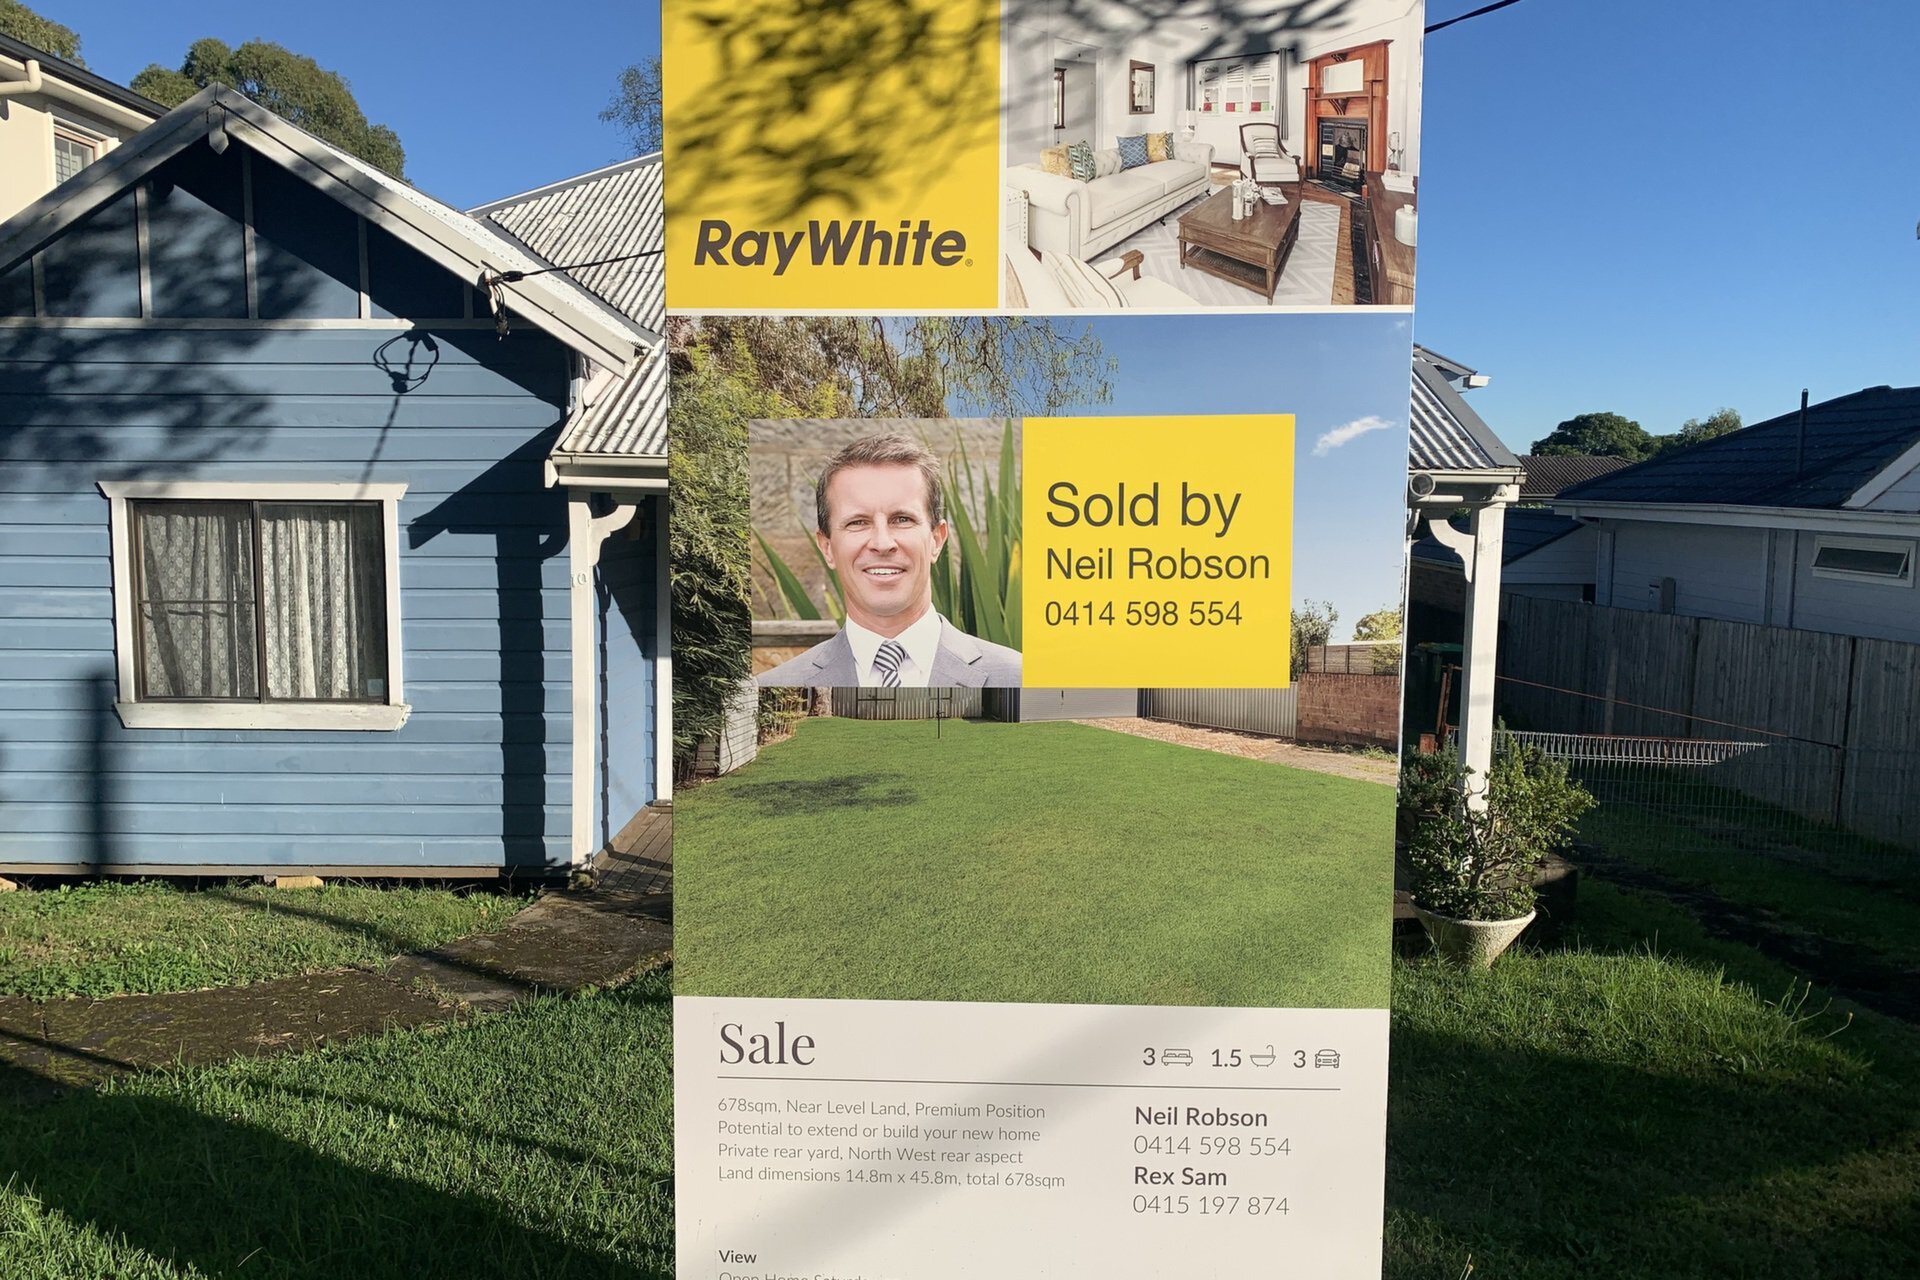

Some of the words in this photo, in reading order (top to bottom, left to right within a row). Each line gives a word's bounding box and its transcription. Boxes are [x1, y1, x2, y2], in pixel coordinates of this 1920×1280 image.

[1047, 482, 1158, 527] Sold
[1182, 482, 1241, 538] by
[1048, 548, 1112, 579] Neil
[1129, 548, 1269, 579] Robson
[1046, 601, 1115, 626] 0414
[1126, 601, 1178, 626] 598
[1190, 601, 1242, 626] 554
[721, 1022, 815, 1065] Sale
[1143, 1048, 1155, 1065] 3
[1212, 1049, 1241, 1067] 1.5
[1294, 1050, 1306, 1068] 3
[718, 1098, 780, 1114] 678sqm,
[787, 1100, 822, 1113] Near
[828, 1101, 865, 1114] Level
[872, 1102, 909, 1117] Land,
[916, 1103, 980, 1117] Premium
[987, 1104, 1045, 1118] Position
[1136, 1107, 1177, 1125] Neil
[1187, 1108, 1267, 1126] Robson
[719, 1121, 782, 1135] Potential
[788, 1123, 802, 1135] to
[808, 1124, 857, 1137] extend
[863, 1128, 878, 1137] or
[884, 1125, 918, 1138] build
[924, 1129, 957, 1141] your
[963, 1130, 993, 1140] new
[999, 1127, 1040, 1141] home
[719, 1143, 768, 1157] Private
[774, 1148, 803, 1158] rear
[807, 1146, 843, 1161] yard,
[849, 1147, 891, 1160] North
[897, 1148, 936, 1161] West
[941, 1152, 970, 1162] rear
[975, 1152, 1022, 1165] aspect
[1134, 1135, 1191, 1154] 0414
[1200, 1137, 1240, 1155] 598
[1250, 1137, 1291, 1156] 554
[719, 1166, 753, 1181] Land
[759, 1167, 840, 1182] dimensions
[847, 1170, 892, 1183] 14.8m
[898, 1174, 905, 1183] x
[910, 1171, 961, 1185] 45.8m,
[967, 1173, 999, 1185] total
[1005, 1173, 1064, 1189] 678sqm
[1135, 1167, 1174, 1185] Rex
[1182, 1167, 1226, 1185] Sam
[1133, 1195, 1188, 1213] 0415
[1200, 1196, 1239, 1214] 197
[1248, 1197, 1289, 1215] 874
[719, 1250, 757, 1263] View
